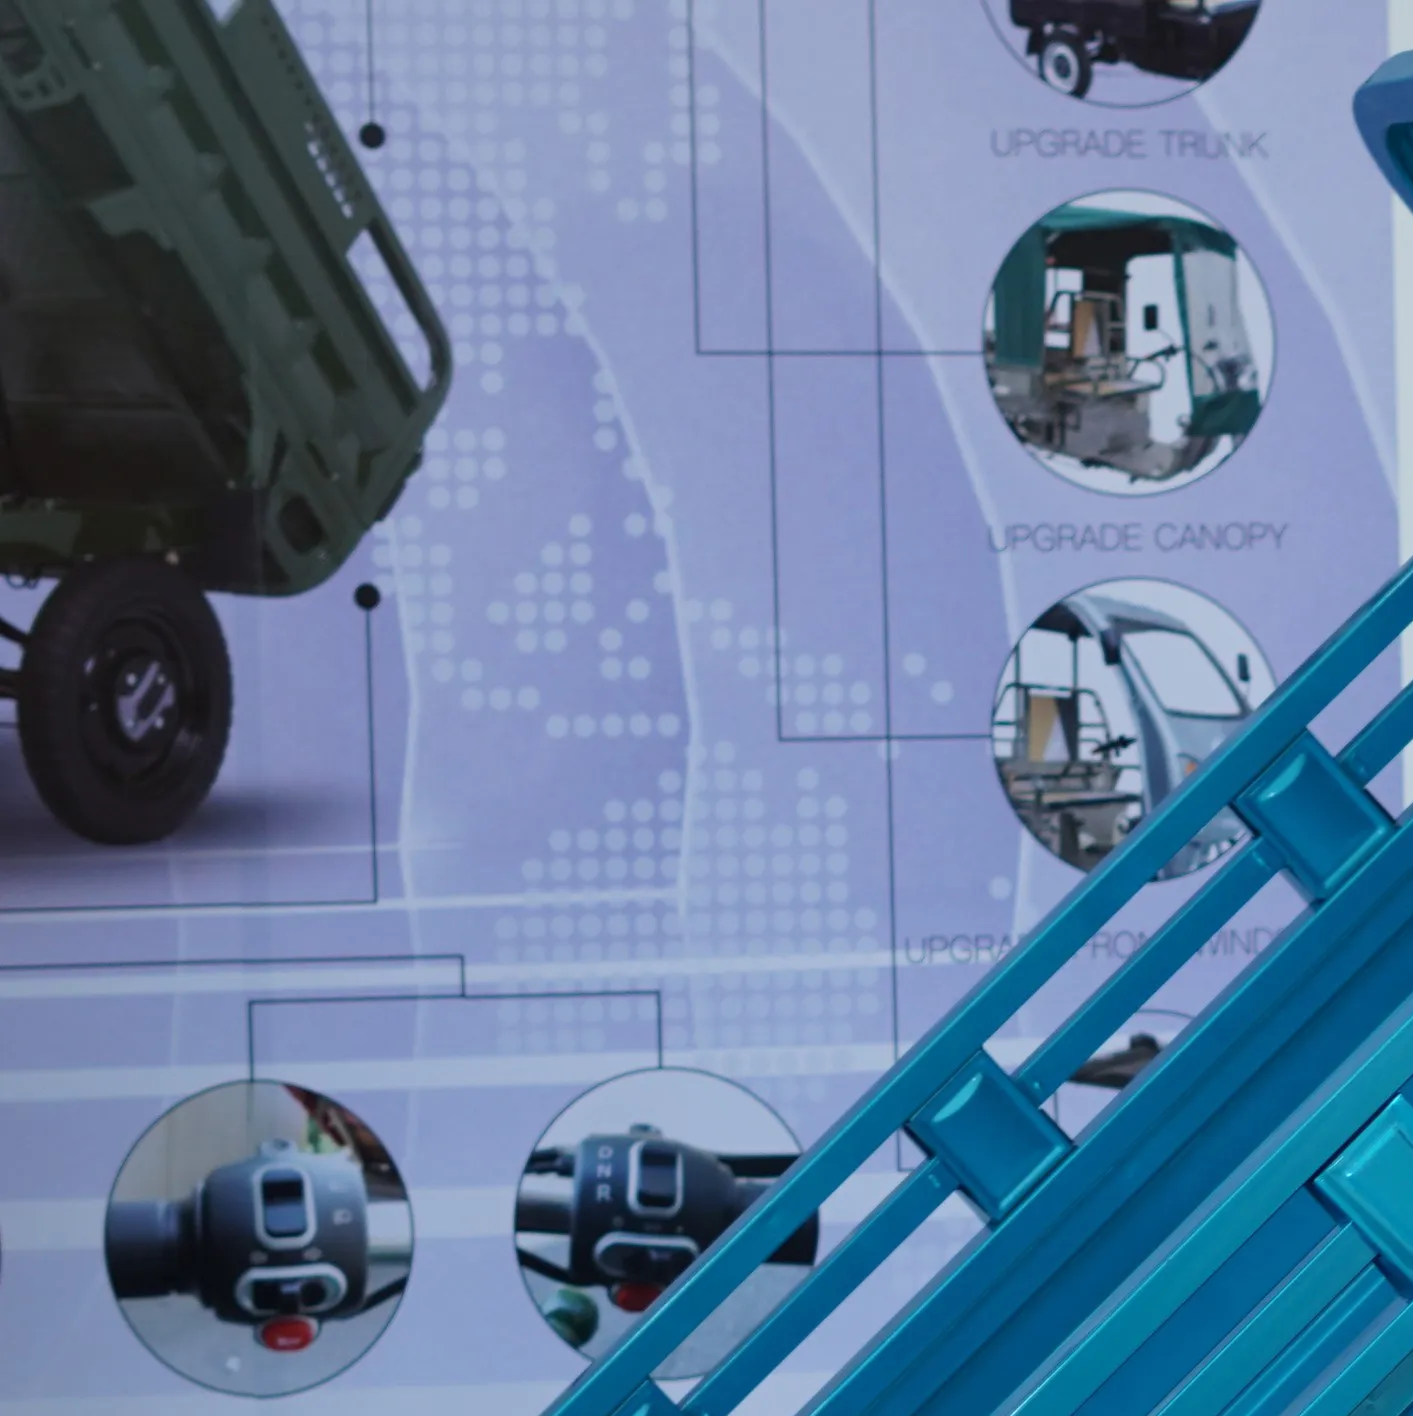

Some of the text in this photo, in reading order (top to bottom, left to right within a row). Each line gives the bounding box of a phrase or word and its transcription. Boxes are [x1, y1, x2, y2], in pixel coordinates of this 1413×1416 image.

[989, 127, 1270, 160] UPGRADE TRUNK
[987, 520, 1289, 553] UPGRADE CANOPY
[904, 932, 1030, 966] UPGRA
